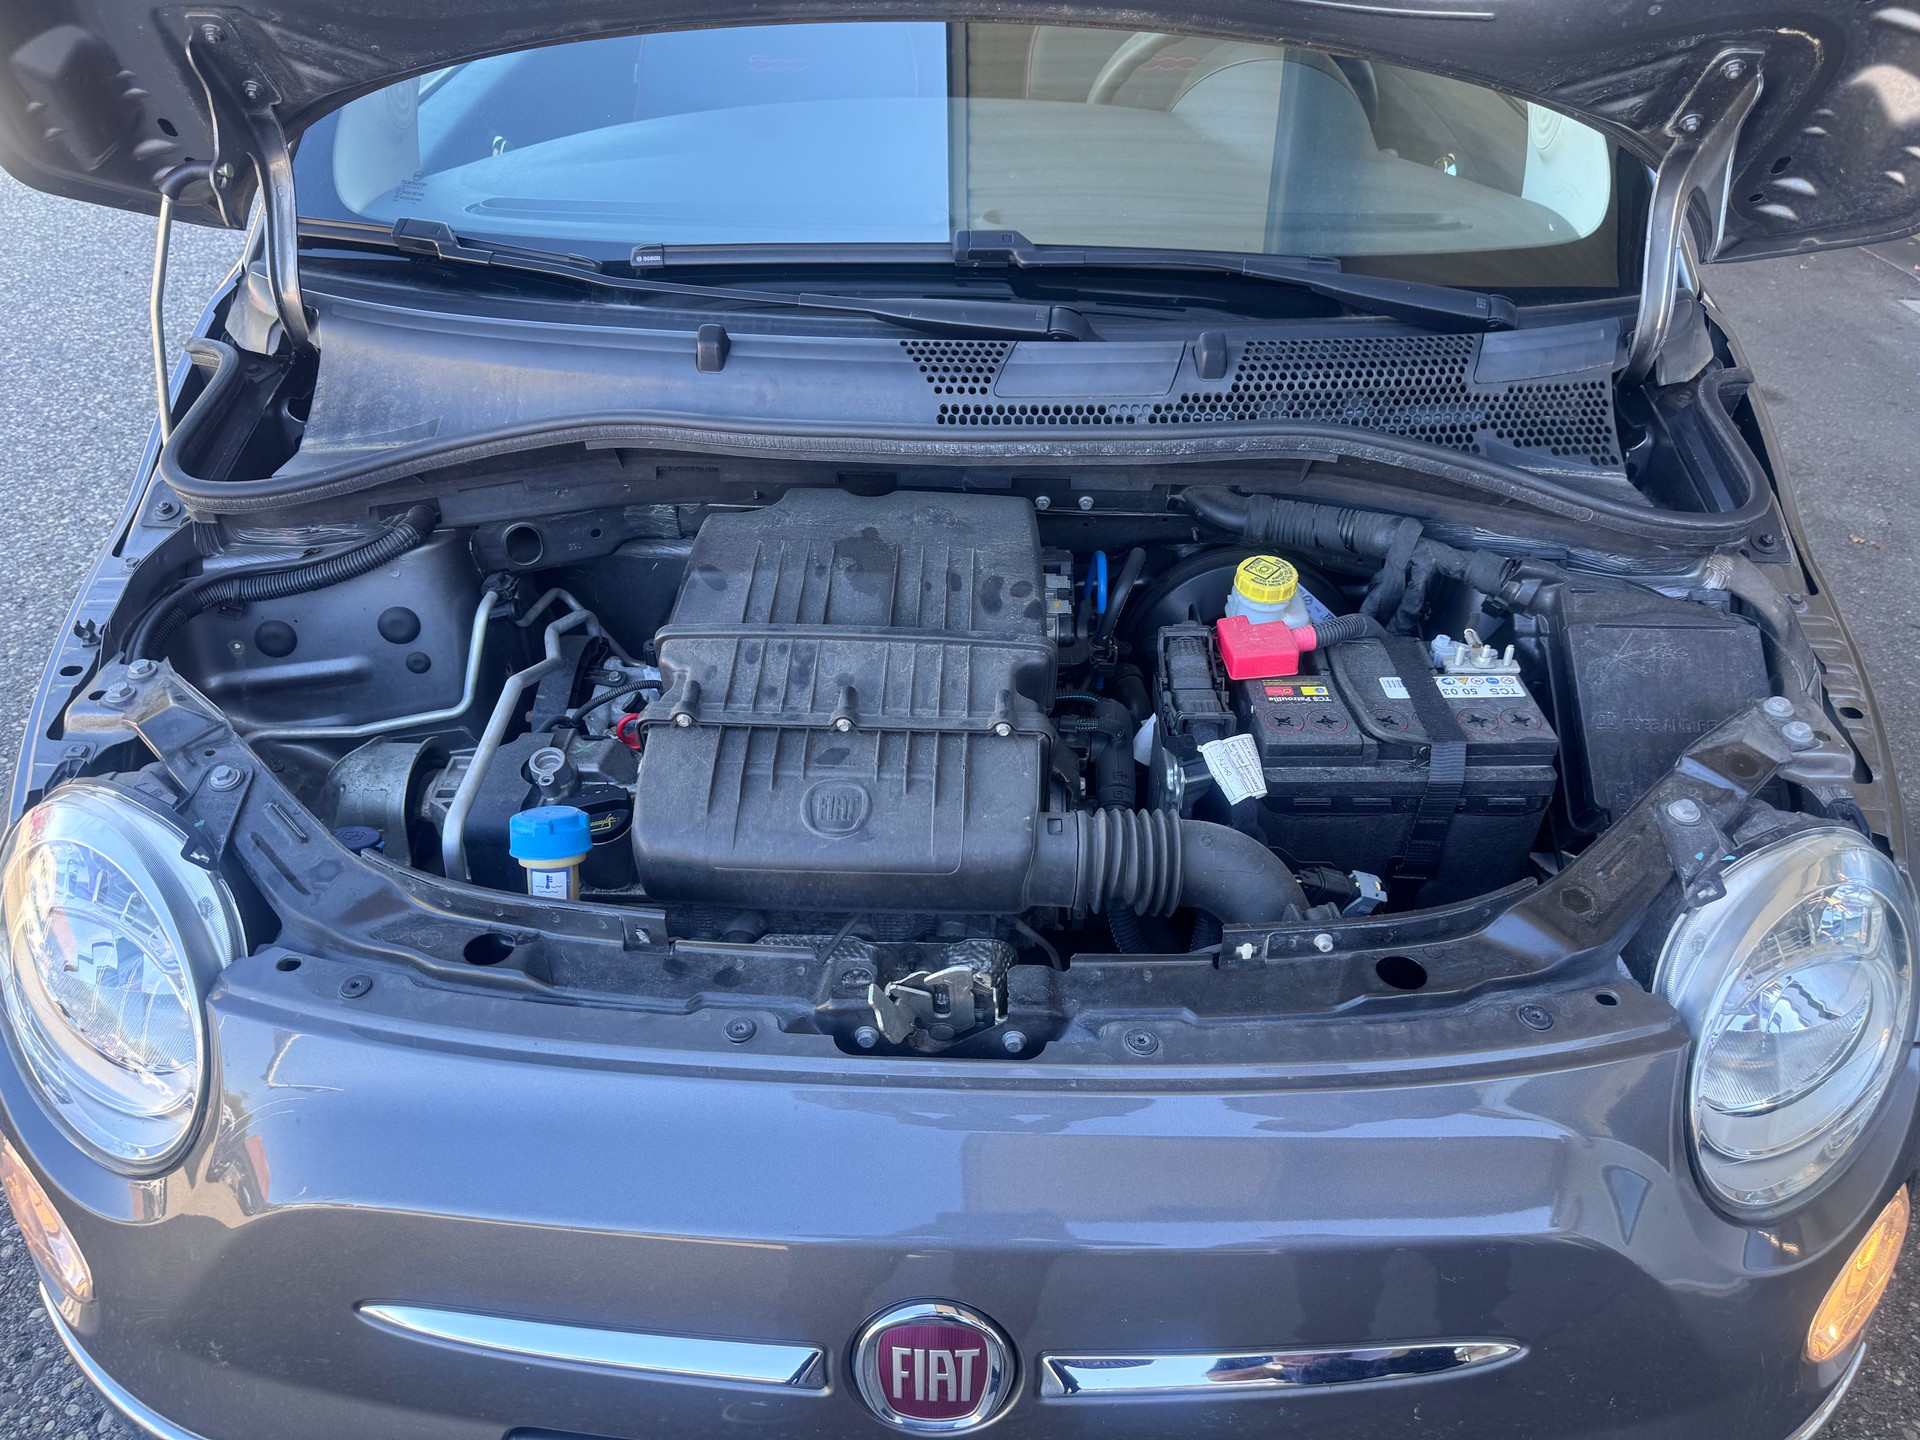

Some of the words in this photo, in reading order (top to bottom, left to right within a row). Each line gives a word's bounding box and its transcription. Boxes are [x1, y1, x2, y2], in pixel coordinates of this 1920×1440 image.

[1442, 687, 1459, 695] 03
[1462, 687, 1478, 695] 50
[1490, 687, 1520, 695] TCS
[816, 794, 860, 821] FIAT
[891, 1346, 981, 1402] FIAT
